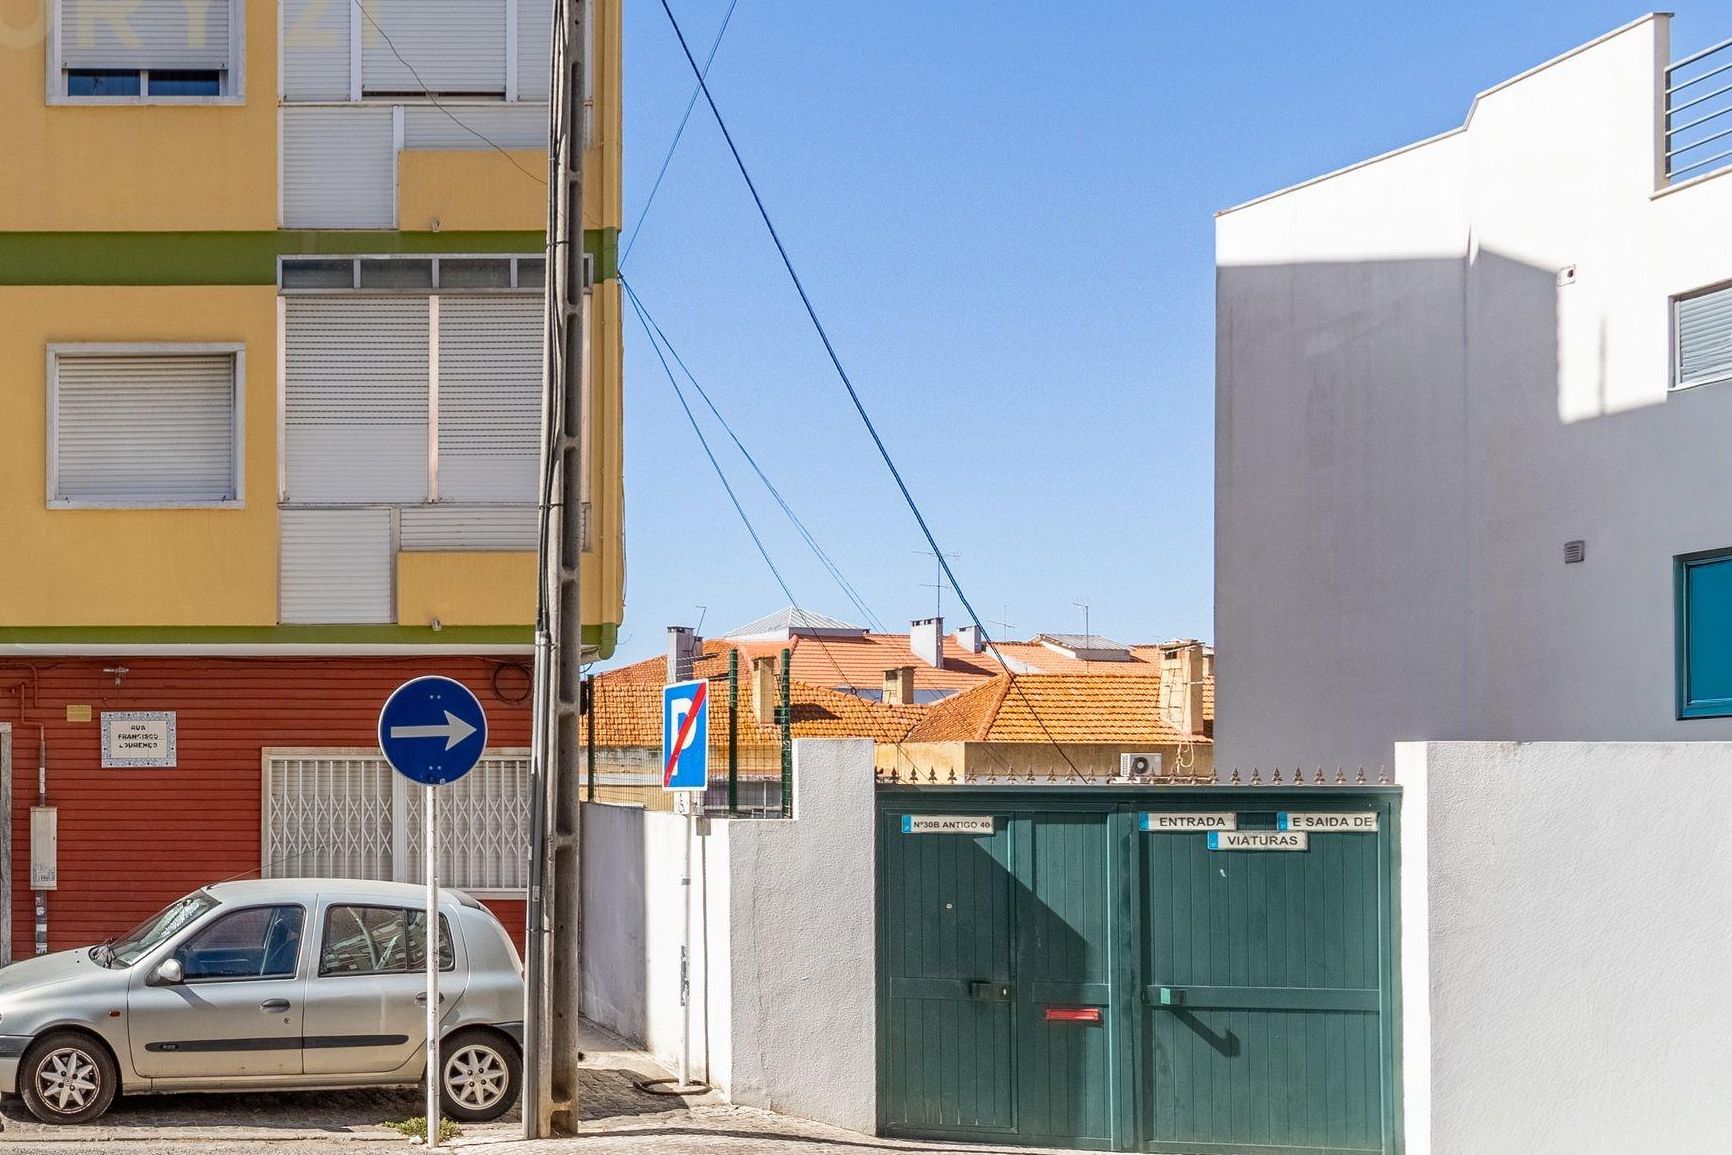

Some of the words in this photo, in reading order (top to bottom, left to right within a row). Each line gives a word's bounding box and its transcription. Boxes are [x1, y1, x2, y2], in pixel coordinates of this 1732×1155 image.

[942, 821, 978, 829] ANTIGO
[980, 821, 991, 829] 40
[1159, 816, 1226, 828] ENTRADA
[1293, 816, 1302, 828] E
[1306, 816, 1349, 828] SAIDA
[1354, 816, 1373, 828] DE
[1227, 835, 1298, 847] VIATURAS
